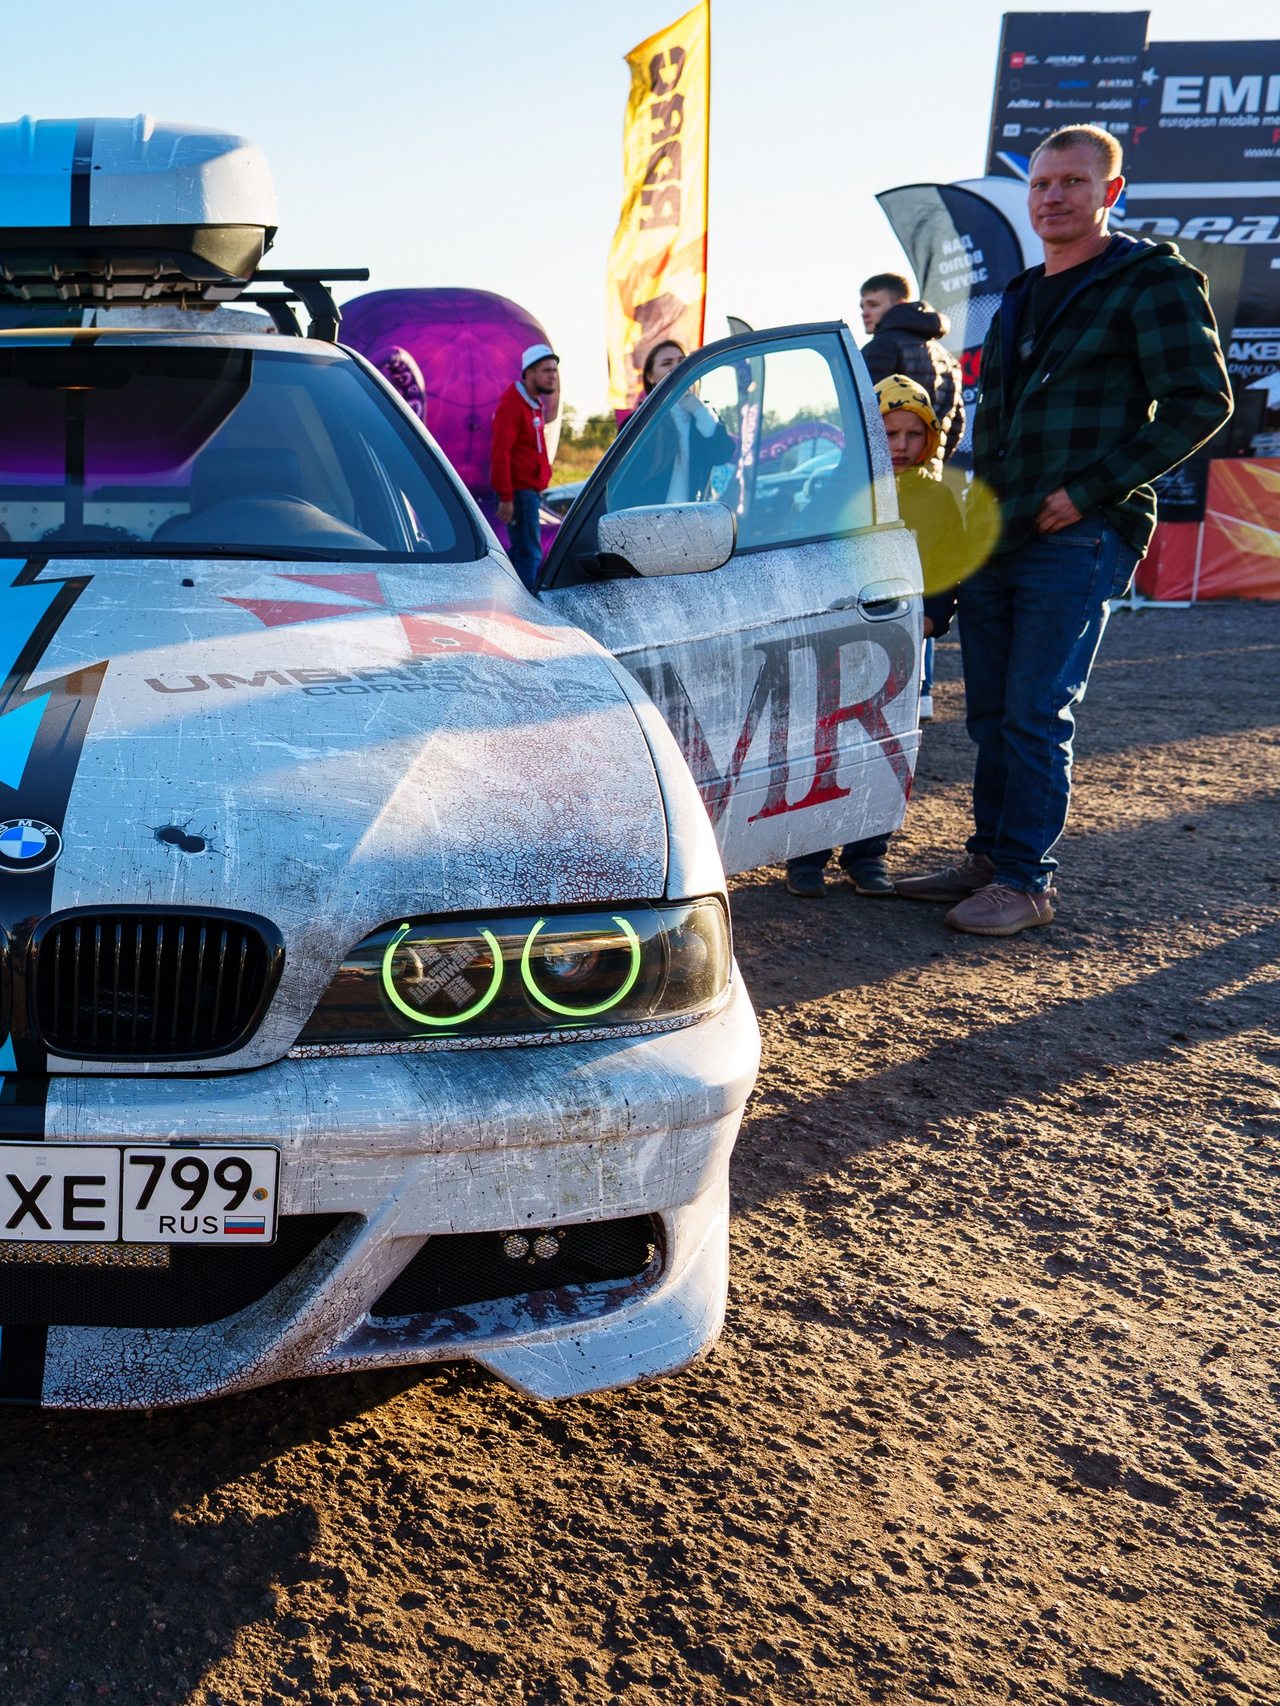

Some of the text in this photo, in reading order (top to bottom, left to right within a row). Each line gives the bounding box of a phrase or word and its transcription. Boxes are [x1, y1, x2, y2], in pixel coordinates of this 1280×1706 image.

[1218, 114, 1261, 127] mobile
[1227, 341, 1280, 361] AKE
[129, 1155, 253, 1211] 799
[159, 1216, 218, 1234] RUS
